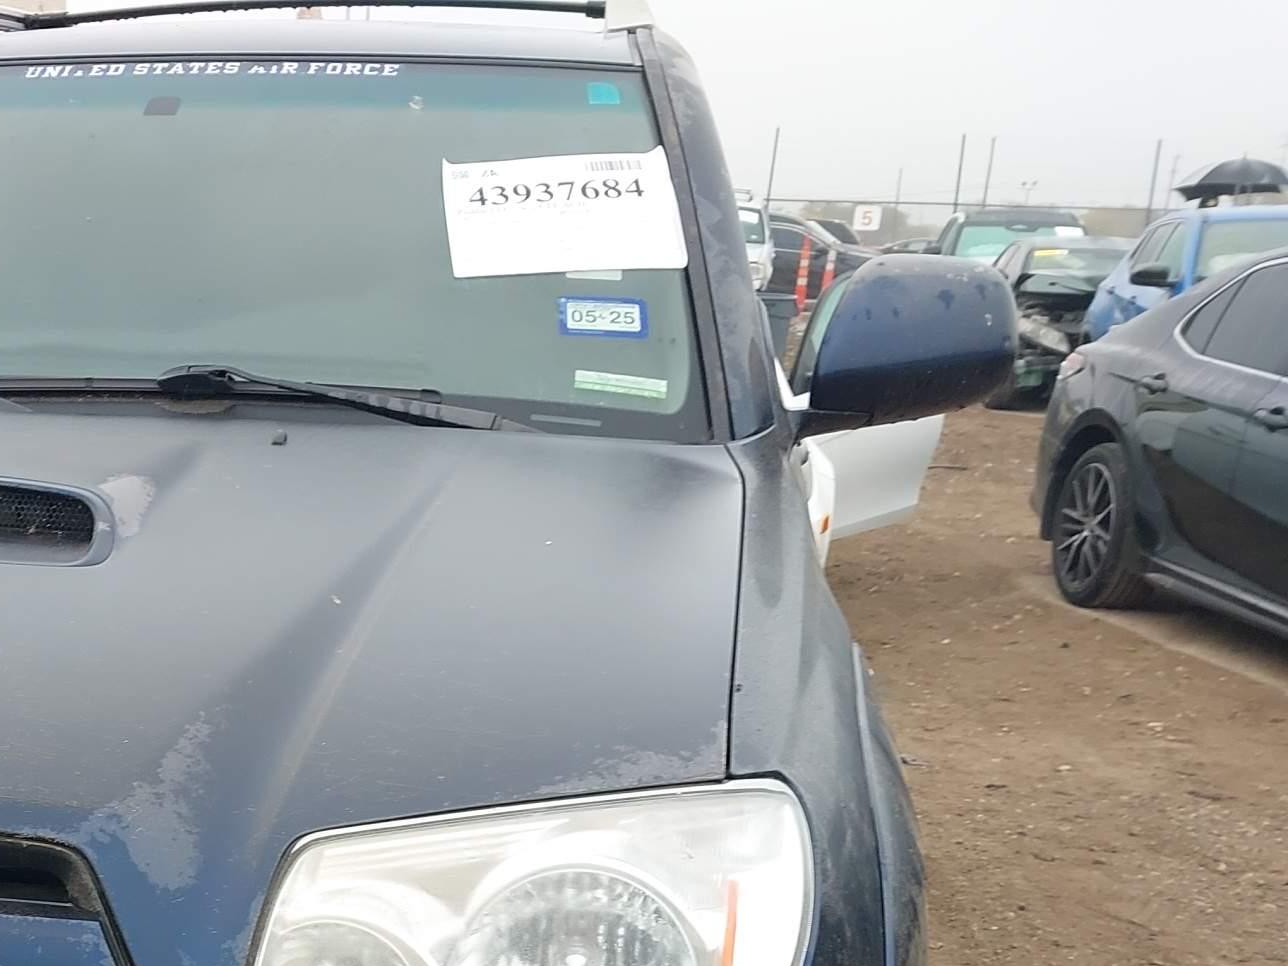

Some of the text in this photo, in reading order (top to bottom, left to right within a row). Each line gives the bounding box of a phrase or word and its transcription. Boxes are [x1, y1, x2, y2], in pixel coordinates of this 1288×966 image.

[133, 61, 241, 76] STATES
[307, 61, 401, 77] FORCE
[469, 178, 645, 206] 43937684
[861, 210, 873, 226] 5
